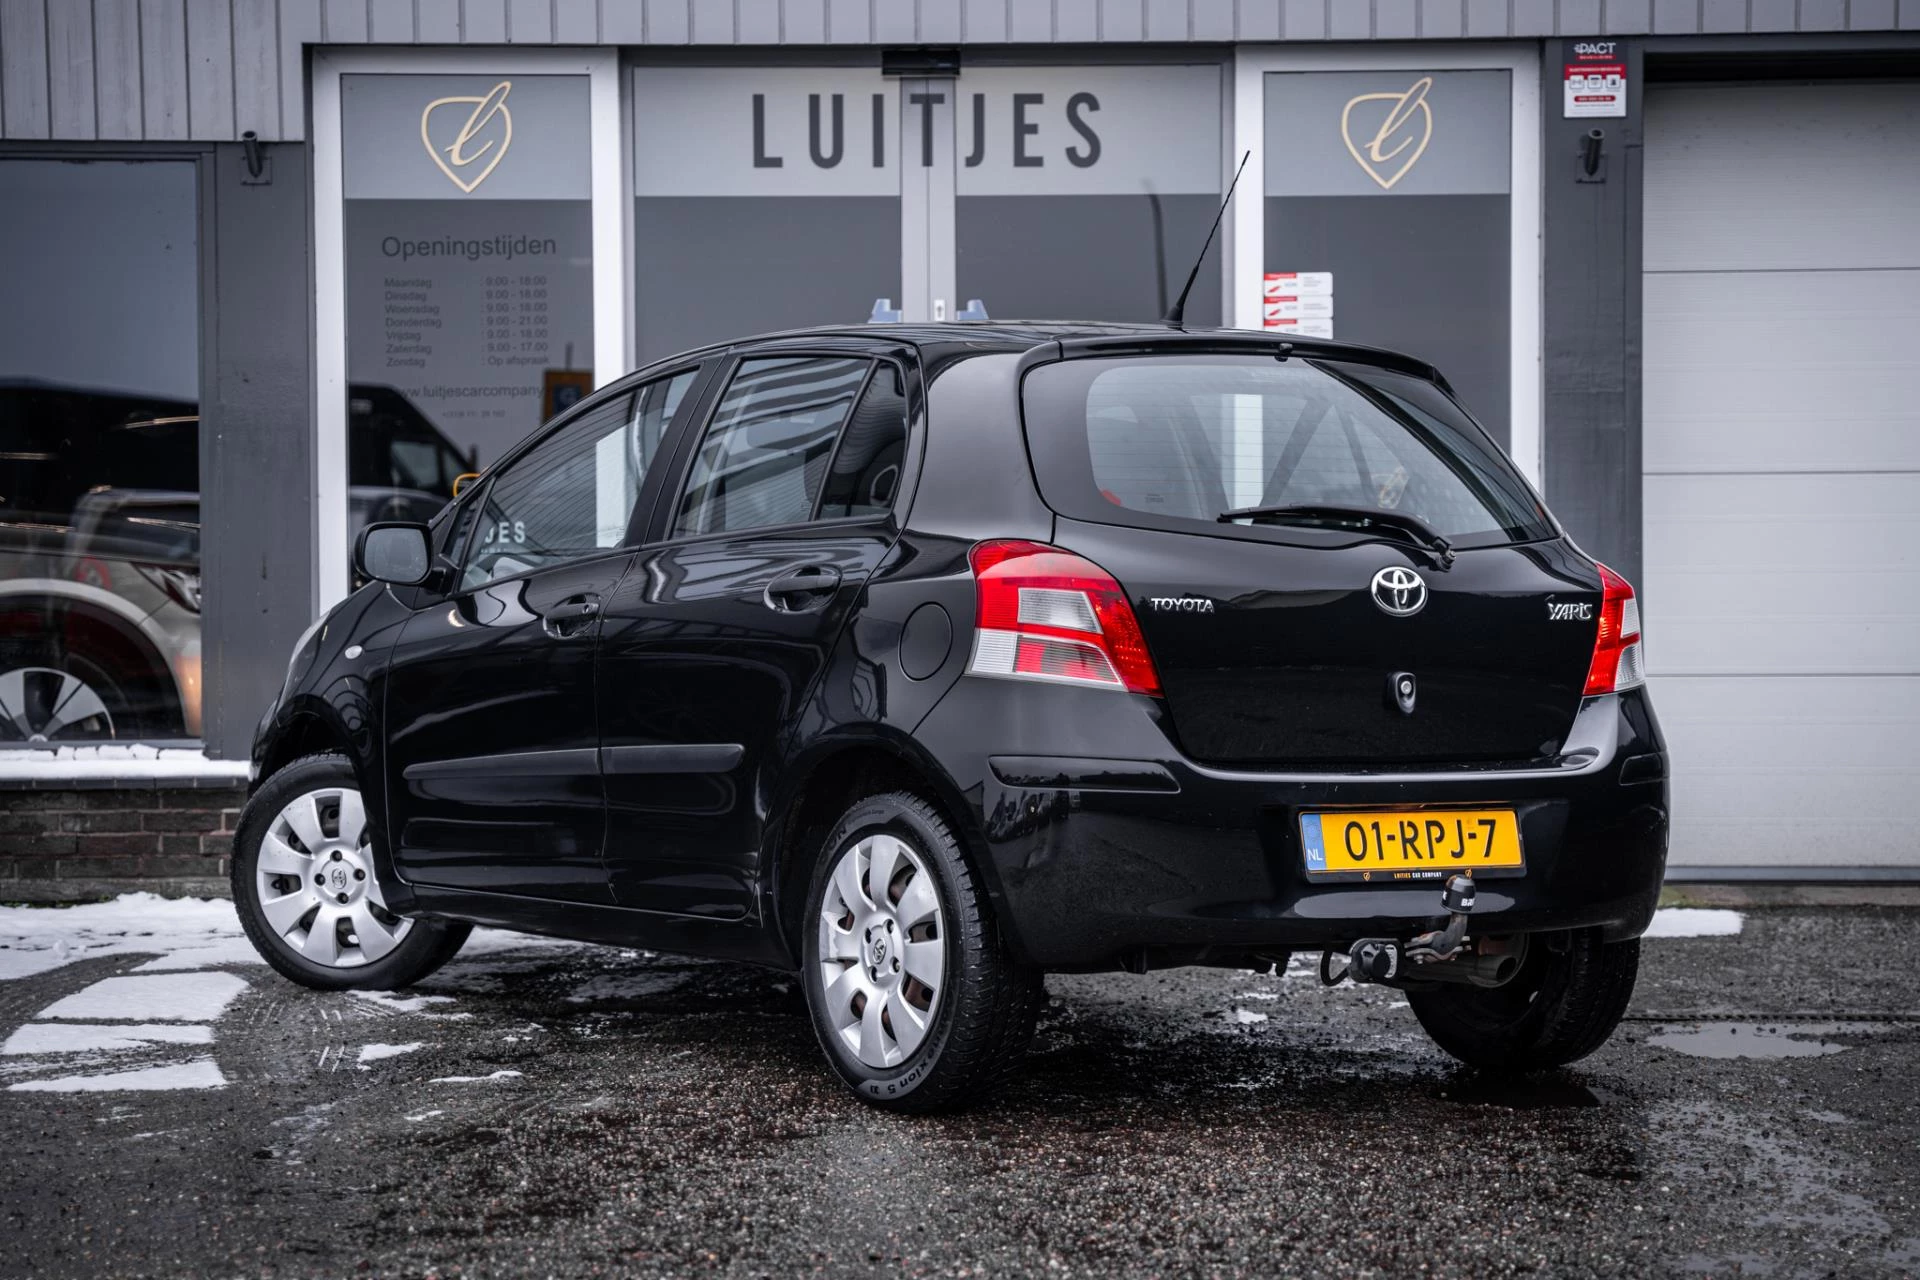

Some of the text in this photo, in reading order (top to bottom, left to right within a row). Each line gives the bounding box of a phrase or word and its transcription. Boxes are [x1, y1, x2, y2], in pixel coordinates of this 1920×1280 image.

[753, 92, 1102, 169] LUITJES
[381, 235, 557, 262] Openingstijden
[384, 278, 432, 289] Maandag
[385, 291, 426, 302] Dinsdag
[385, 303, 440, 316] Woensdag
[385, 317, 442, 329] Donderdag
[386, 331, 421, 343] Vrijdag
[386, 344, 432, 356] Zaterdag
[387, 354, 549, 368] Zondag Op afspraak
[1150, 597, 1215, 613] TOYOTA
[1547, 602, 1593, 621] YARIS
[1344, 819, 1497, 862] 01-RPJ-7
[1307, 848, 1323, 861] NL
